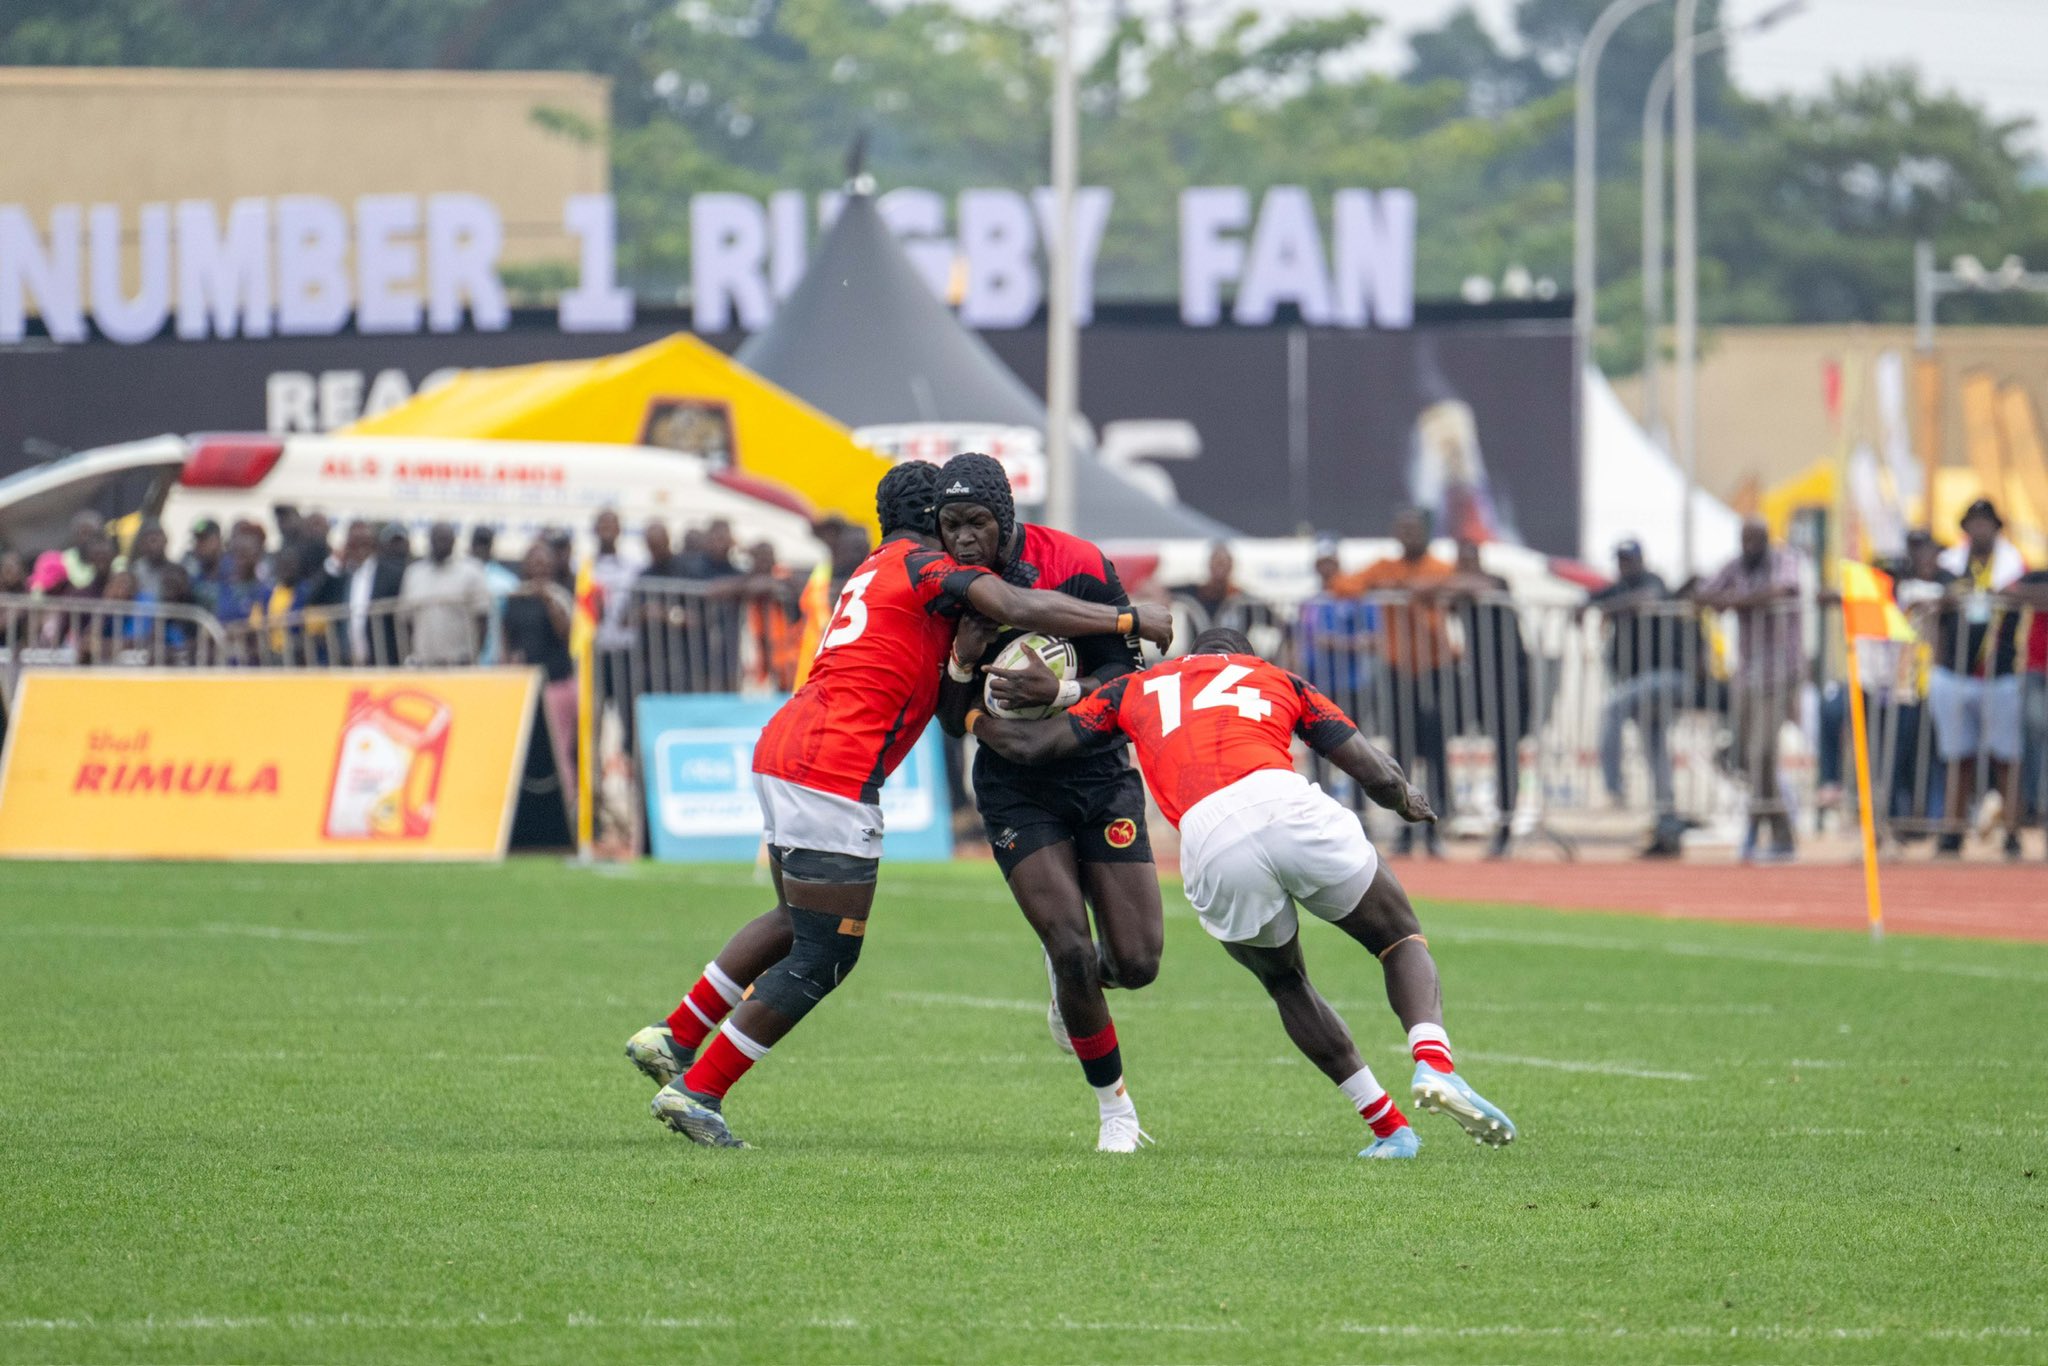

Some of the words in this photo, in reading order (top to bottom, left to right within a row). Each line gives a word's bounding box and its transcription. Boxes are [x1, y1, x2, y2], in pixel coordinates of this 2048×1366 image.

[0, 193, 511, 344] NUMBER
[558, 192, 635, 332] 1
[1180, 186, 1416, 328] FAN
[266, 369, 462, 434] REA
[1143, 663, 1272, 738] 14
[72, 763, 280, 795] RIMULA
